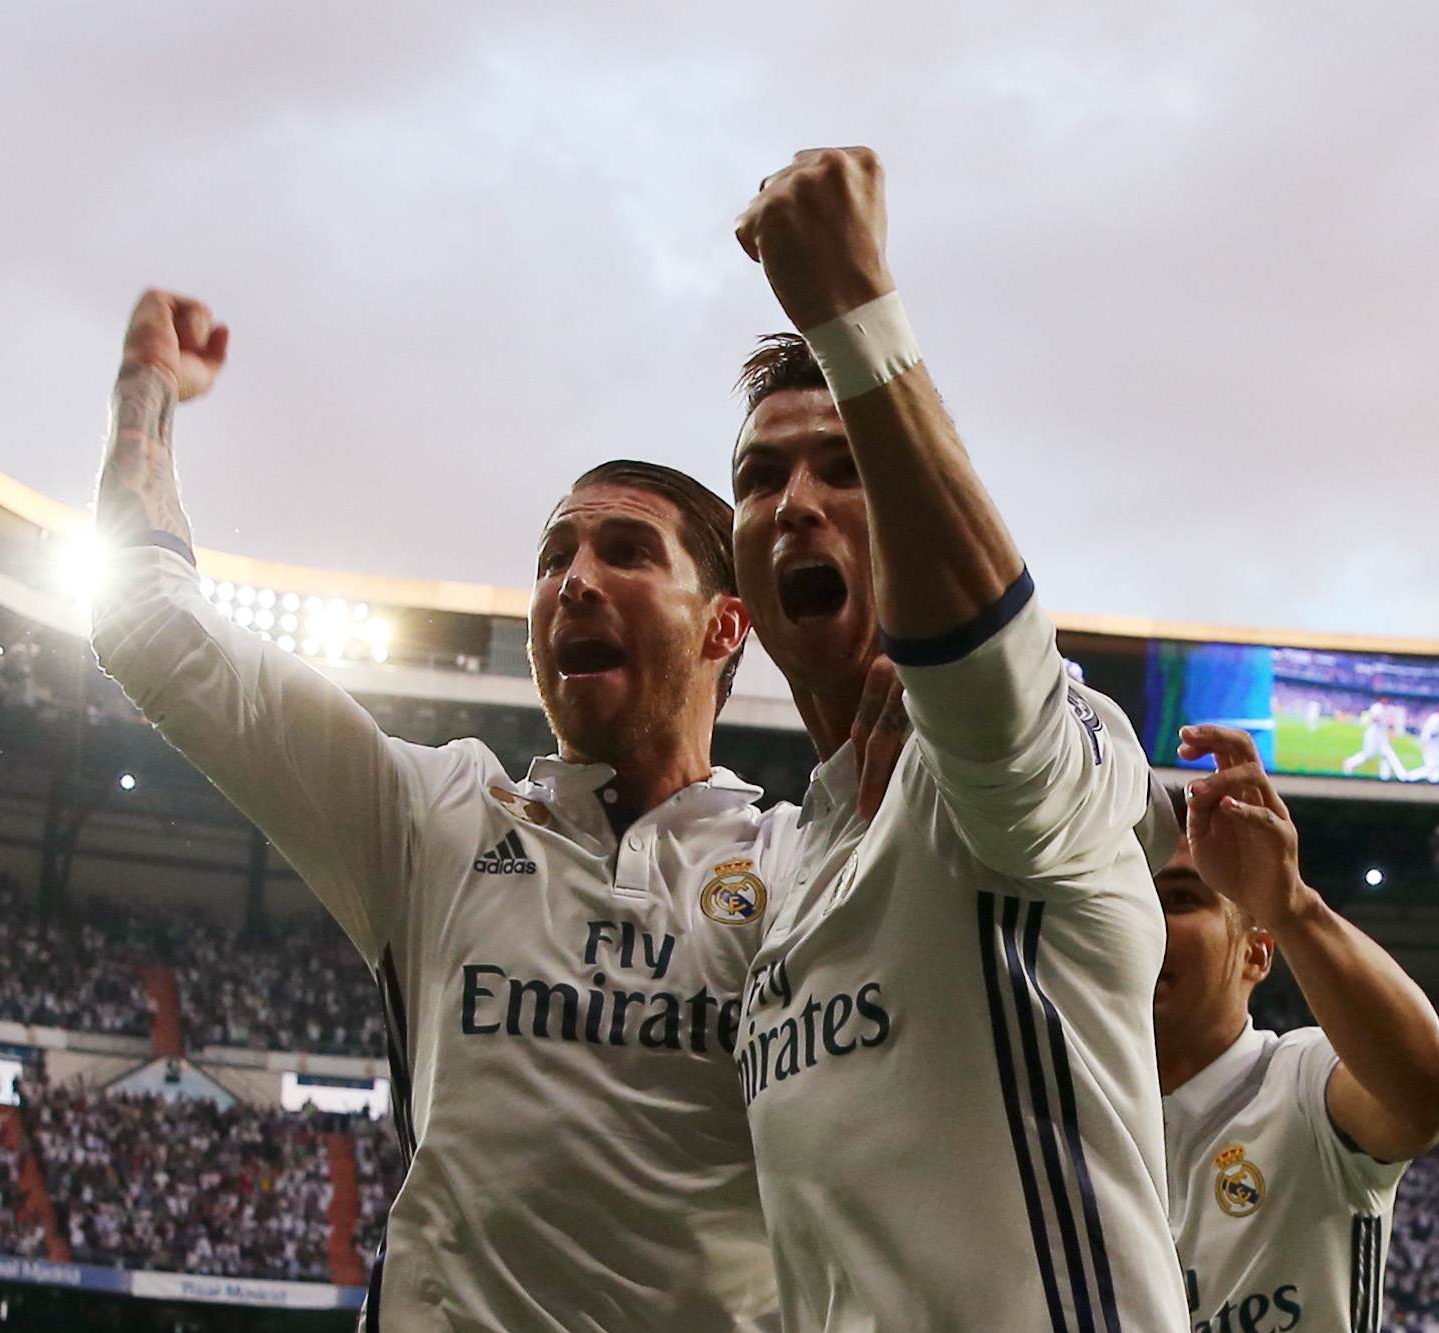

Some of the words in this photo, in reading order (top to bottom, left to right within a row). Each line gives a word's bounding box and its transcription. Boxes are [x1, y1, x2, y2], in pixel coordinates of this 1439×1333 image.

[474, 857, 537, 875] adidas
[584, 921, 675, 979] Fly
[462, 964, 743, 1054] Emirate
